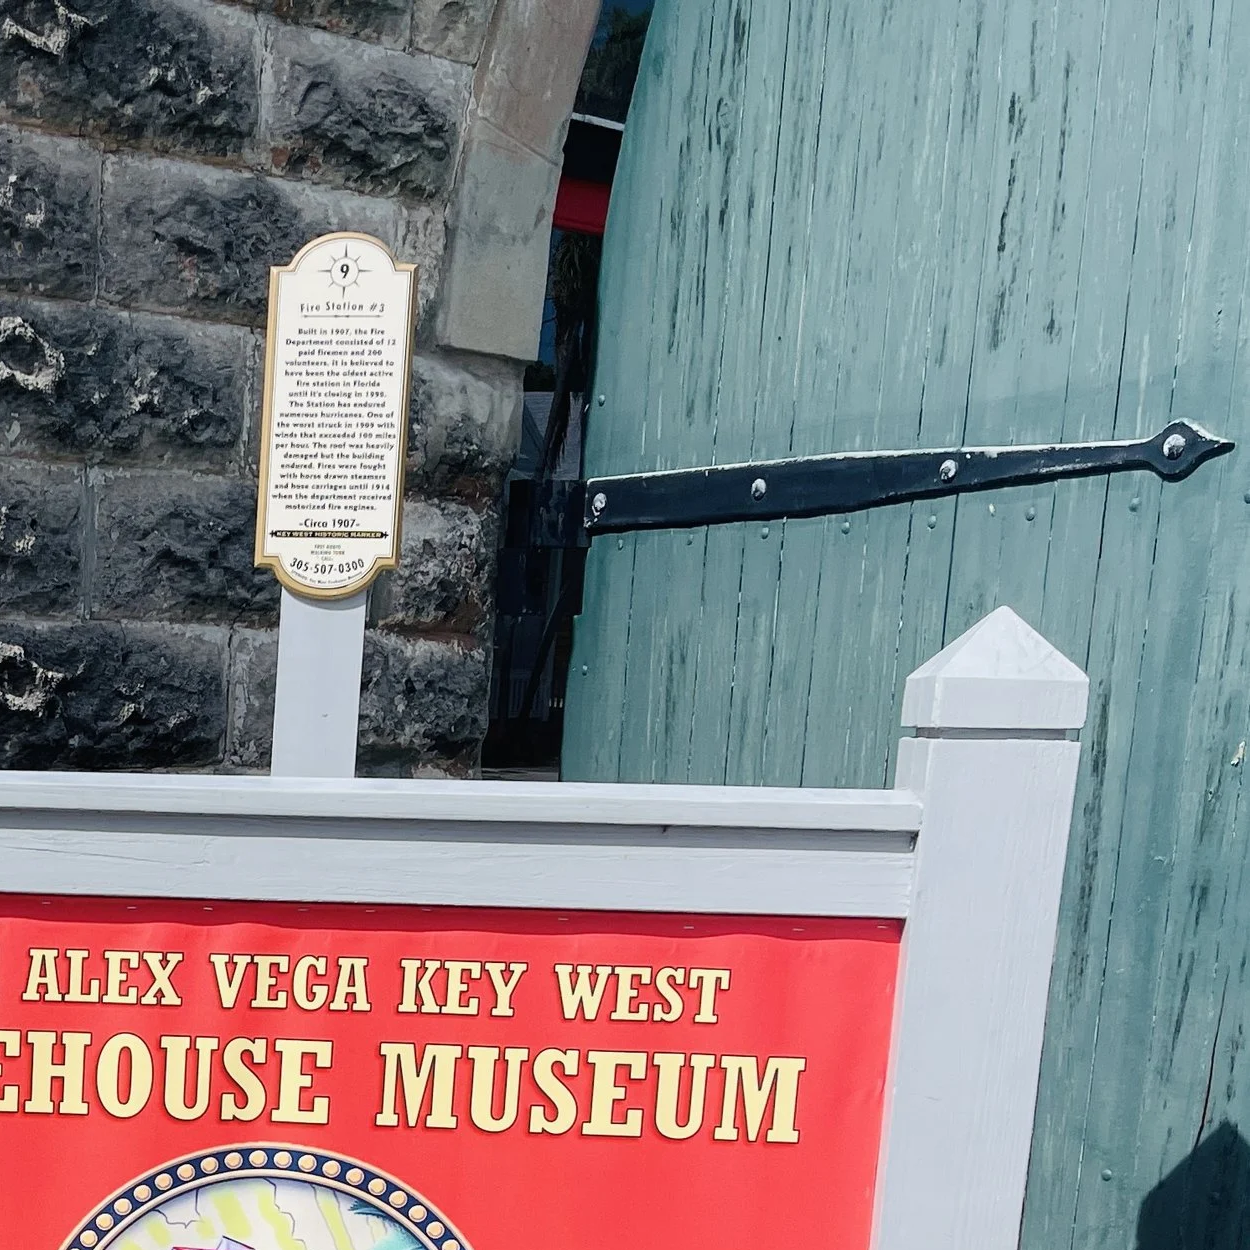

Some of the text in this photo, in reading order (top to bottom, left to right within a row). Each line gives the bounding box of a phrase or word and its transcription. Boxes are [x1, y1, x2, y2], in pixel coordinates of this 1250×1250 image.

[340, 263, 350, 279] 9
[300, 301, 385, 313] Fire Station #3
[370, 327, 385, 335] Fire
[285, 338, 333, 347] Department
[335, 338, 374, 346] consisted
[298, 348, 316, 357] paid
[317, 348, 349, 356] firemen
[350, 348, 365, 356] and
[305, 369, 325, 377] been
[326, 369, 340, 377] the
[342, 369, 367, 377] oldest
[296, 379, 310, 387] fire
[288, 400, 304, 408] The
[306, 400, 336, 408] Station
[337, 400, 351, 408] has
[385, 410, 394, 419] of
[276, 420, 290, 428] the
[376, 421, 395, 429] with
[318, 431, 356, 439] exceeded
[375, 431, 397, 439] miles
[311, 441, 327, 449] The
[329, 441, 346, 449] roof
[365, 442, 395, 451] heavily
[283, 451, 319, 461] damaged
[336, 451, 350, 459] the
[351, 452, 385, 461] building
[359, 462, 386, 471] fought
[299, 472, 322, 480] horse
[323, 472, 349, 480] drawn
[290, 482, 309, 490] hose
[311, 483, 347, 491] carriages
[371, 483, 390, 491] 1914
[294, 492, 309, 500] the
[310, 492, 357, 501] department
[358, 493, 392, 501] received
[284, 502, 326, 510] motorized
[328, 502, 342, 510] fire
[21, 948, 184, 1006] ALEX
[209, 953, 372, 1012] VEGA
[397, 958, 528, 1017] KEY
[553, 963, 731, 1024] WEST
[375, 1042, 807, 1144] MUSEUM
